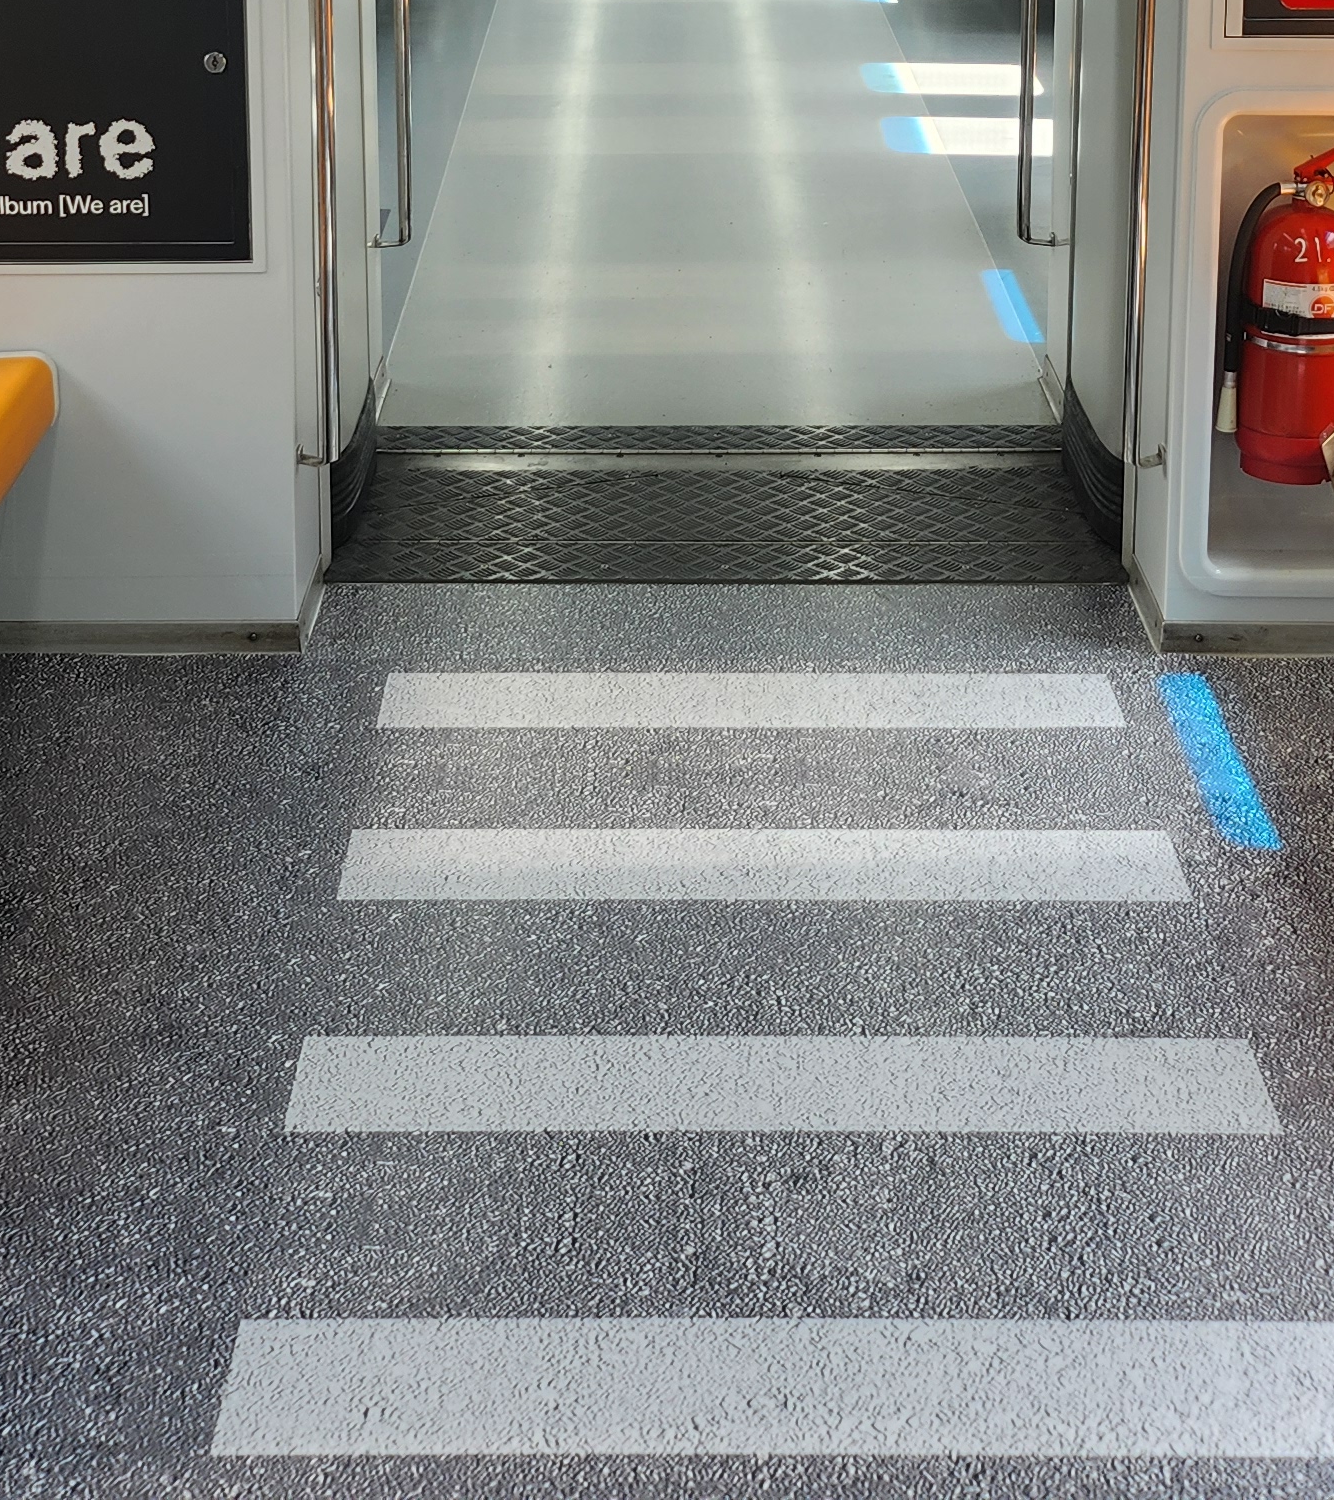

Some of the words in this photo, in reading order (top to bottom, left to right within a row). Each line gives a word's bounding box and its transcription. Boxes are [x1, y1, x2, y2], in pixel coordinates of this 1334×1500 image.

[5, 118, 156, 180] are
[59, 194, 104, 217] [We
[109, 194, 150, 217] are]
